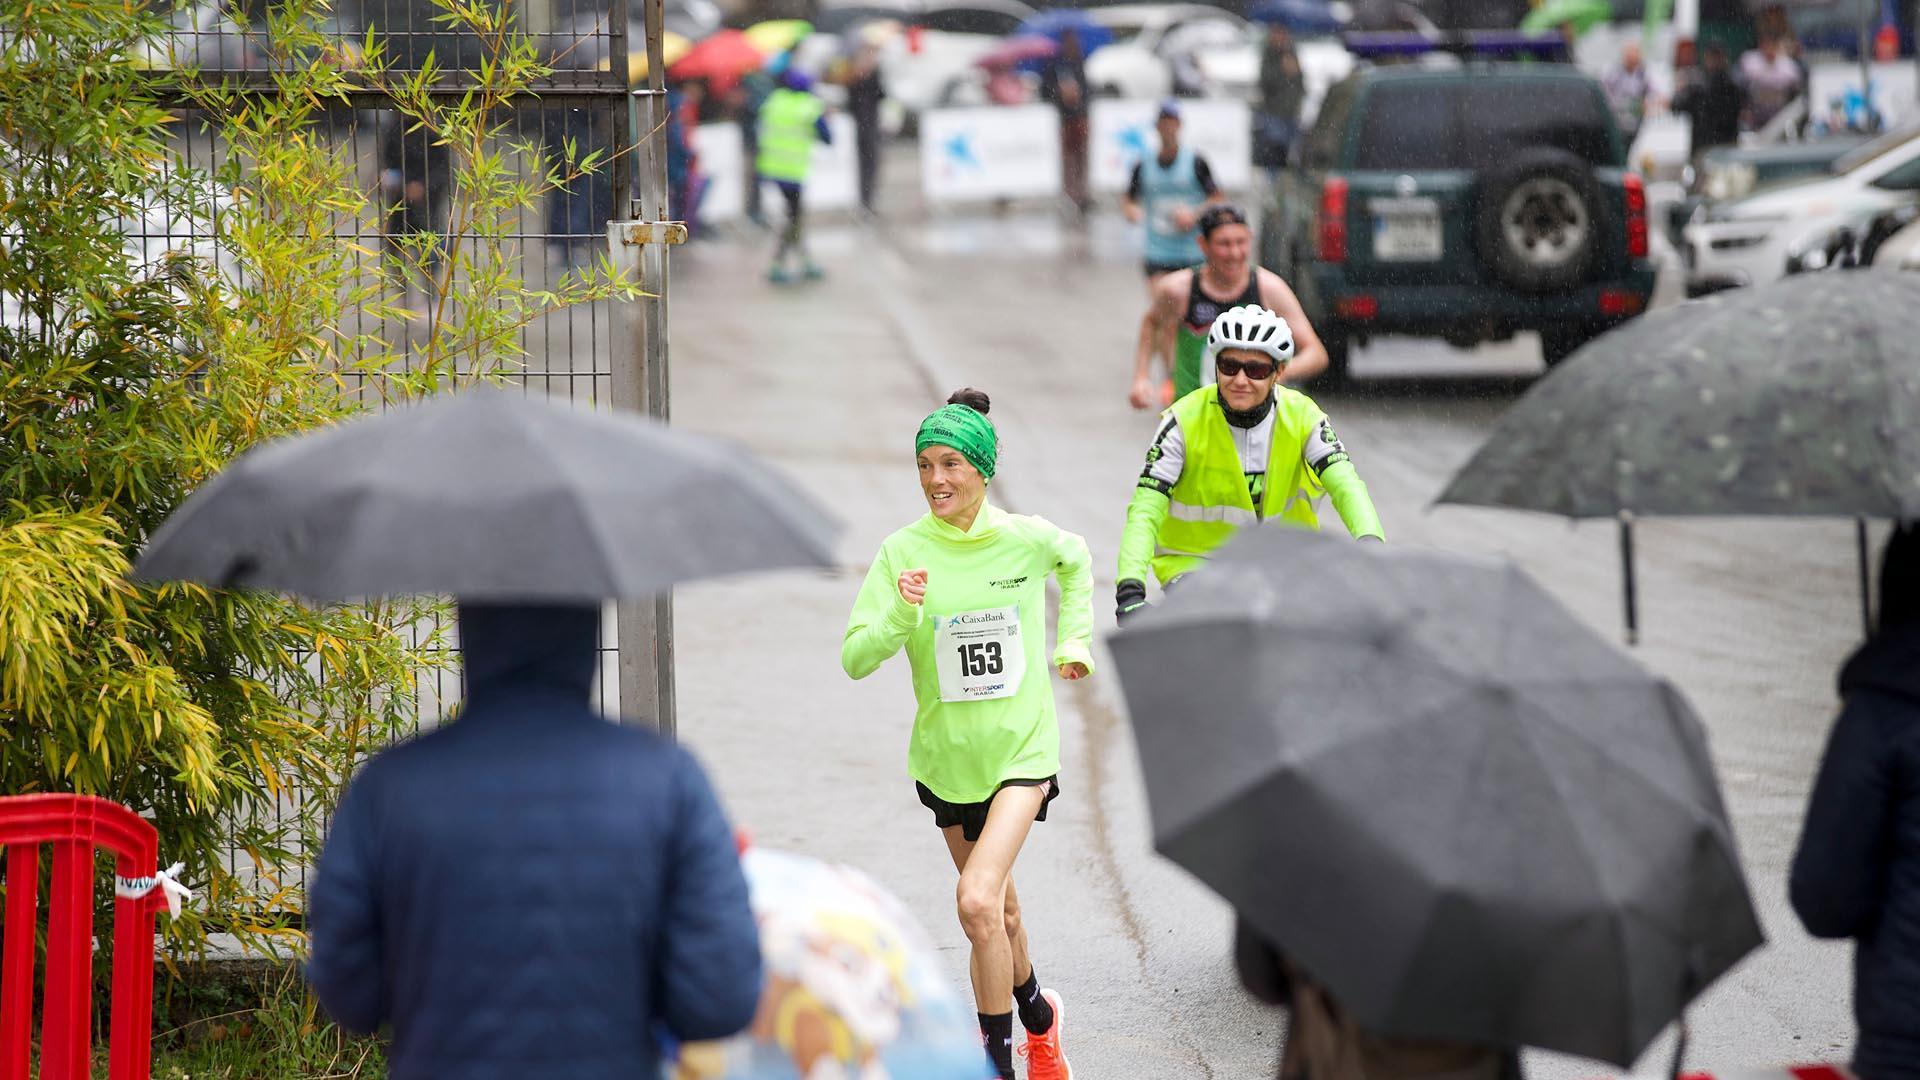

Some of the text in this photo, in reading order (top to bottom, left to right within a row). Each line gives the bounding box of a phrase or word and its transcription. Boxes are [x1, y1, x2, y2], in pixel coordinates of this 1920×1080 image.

[961, 613, 1005, 624] CaixaBank
[957, 641, 1003, 677] 153
[970, 684, 1004, 692] INTERSPORT
